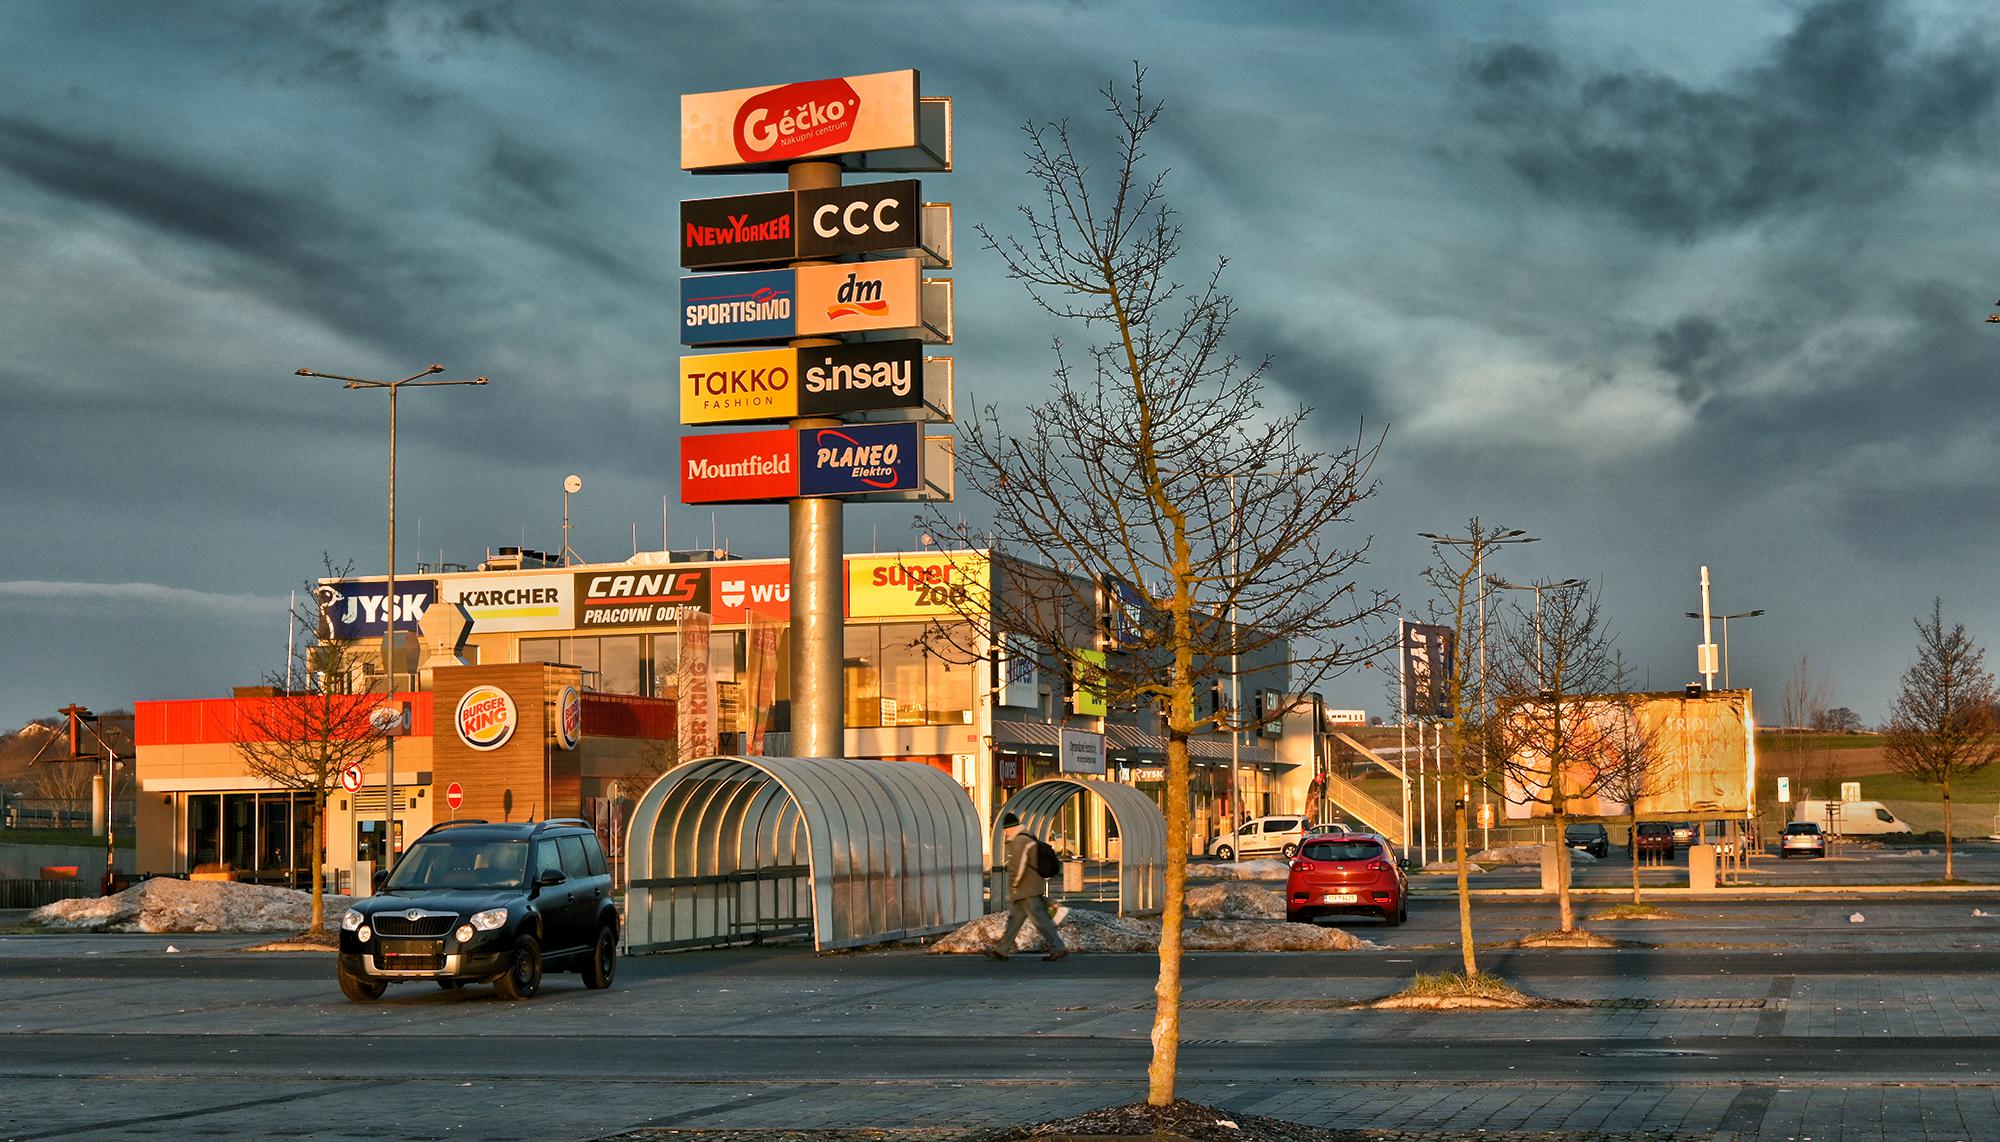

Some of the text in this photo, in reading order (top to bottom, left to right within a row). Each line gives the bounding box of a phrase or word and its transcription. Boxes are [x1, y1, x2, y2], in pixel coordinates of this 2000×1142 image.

[743, 100, 845, 152] Géčko
[780, 121, 848, 147] Nákupní centrum
[813, 198, 900, 238] CCC
[837, 273, 882, 304] dm
[805, 357, 911, 397] sinsay
[704, 396, 773, 410] FASHION
[687, 453, 790, 480] Mountfield
[817, 443, 898, 468] PLANEO
[852, 466, 892, 478] Elektro
[587, 572, 701, 598] CANIS
[872, 564, 957, 591] super
[341, 593, 427, 624] JYSK
[460, 587, 559, 607] KÄRCHER
[584, 604, 654, 624] PRACOVNÍ
[690, 661, 708, 715] KING
[463, 698, 505, 722] BURGER
[465, 707, 507, 737] KING
